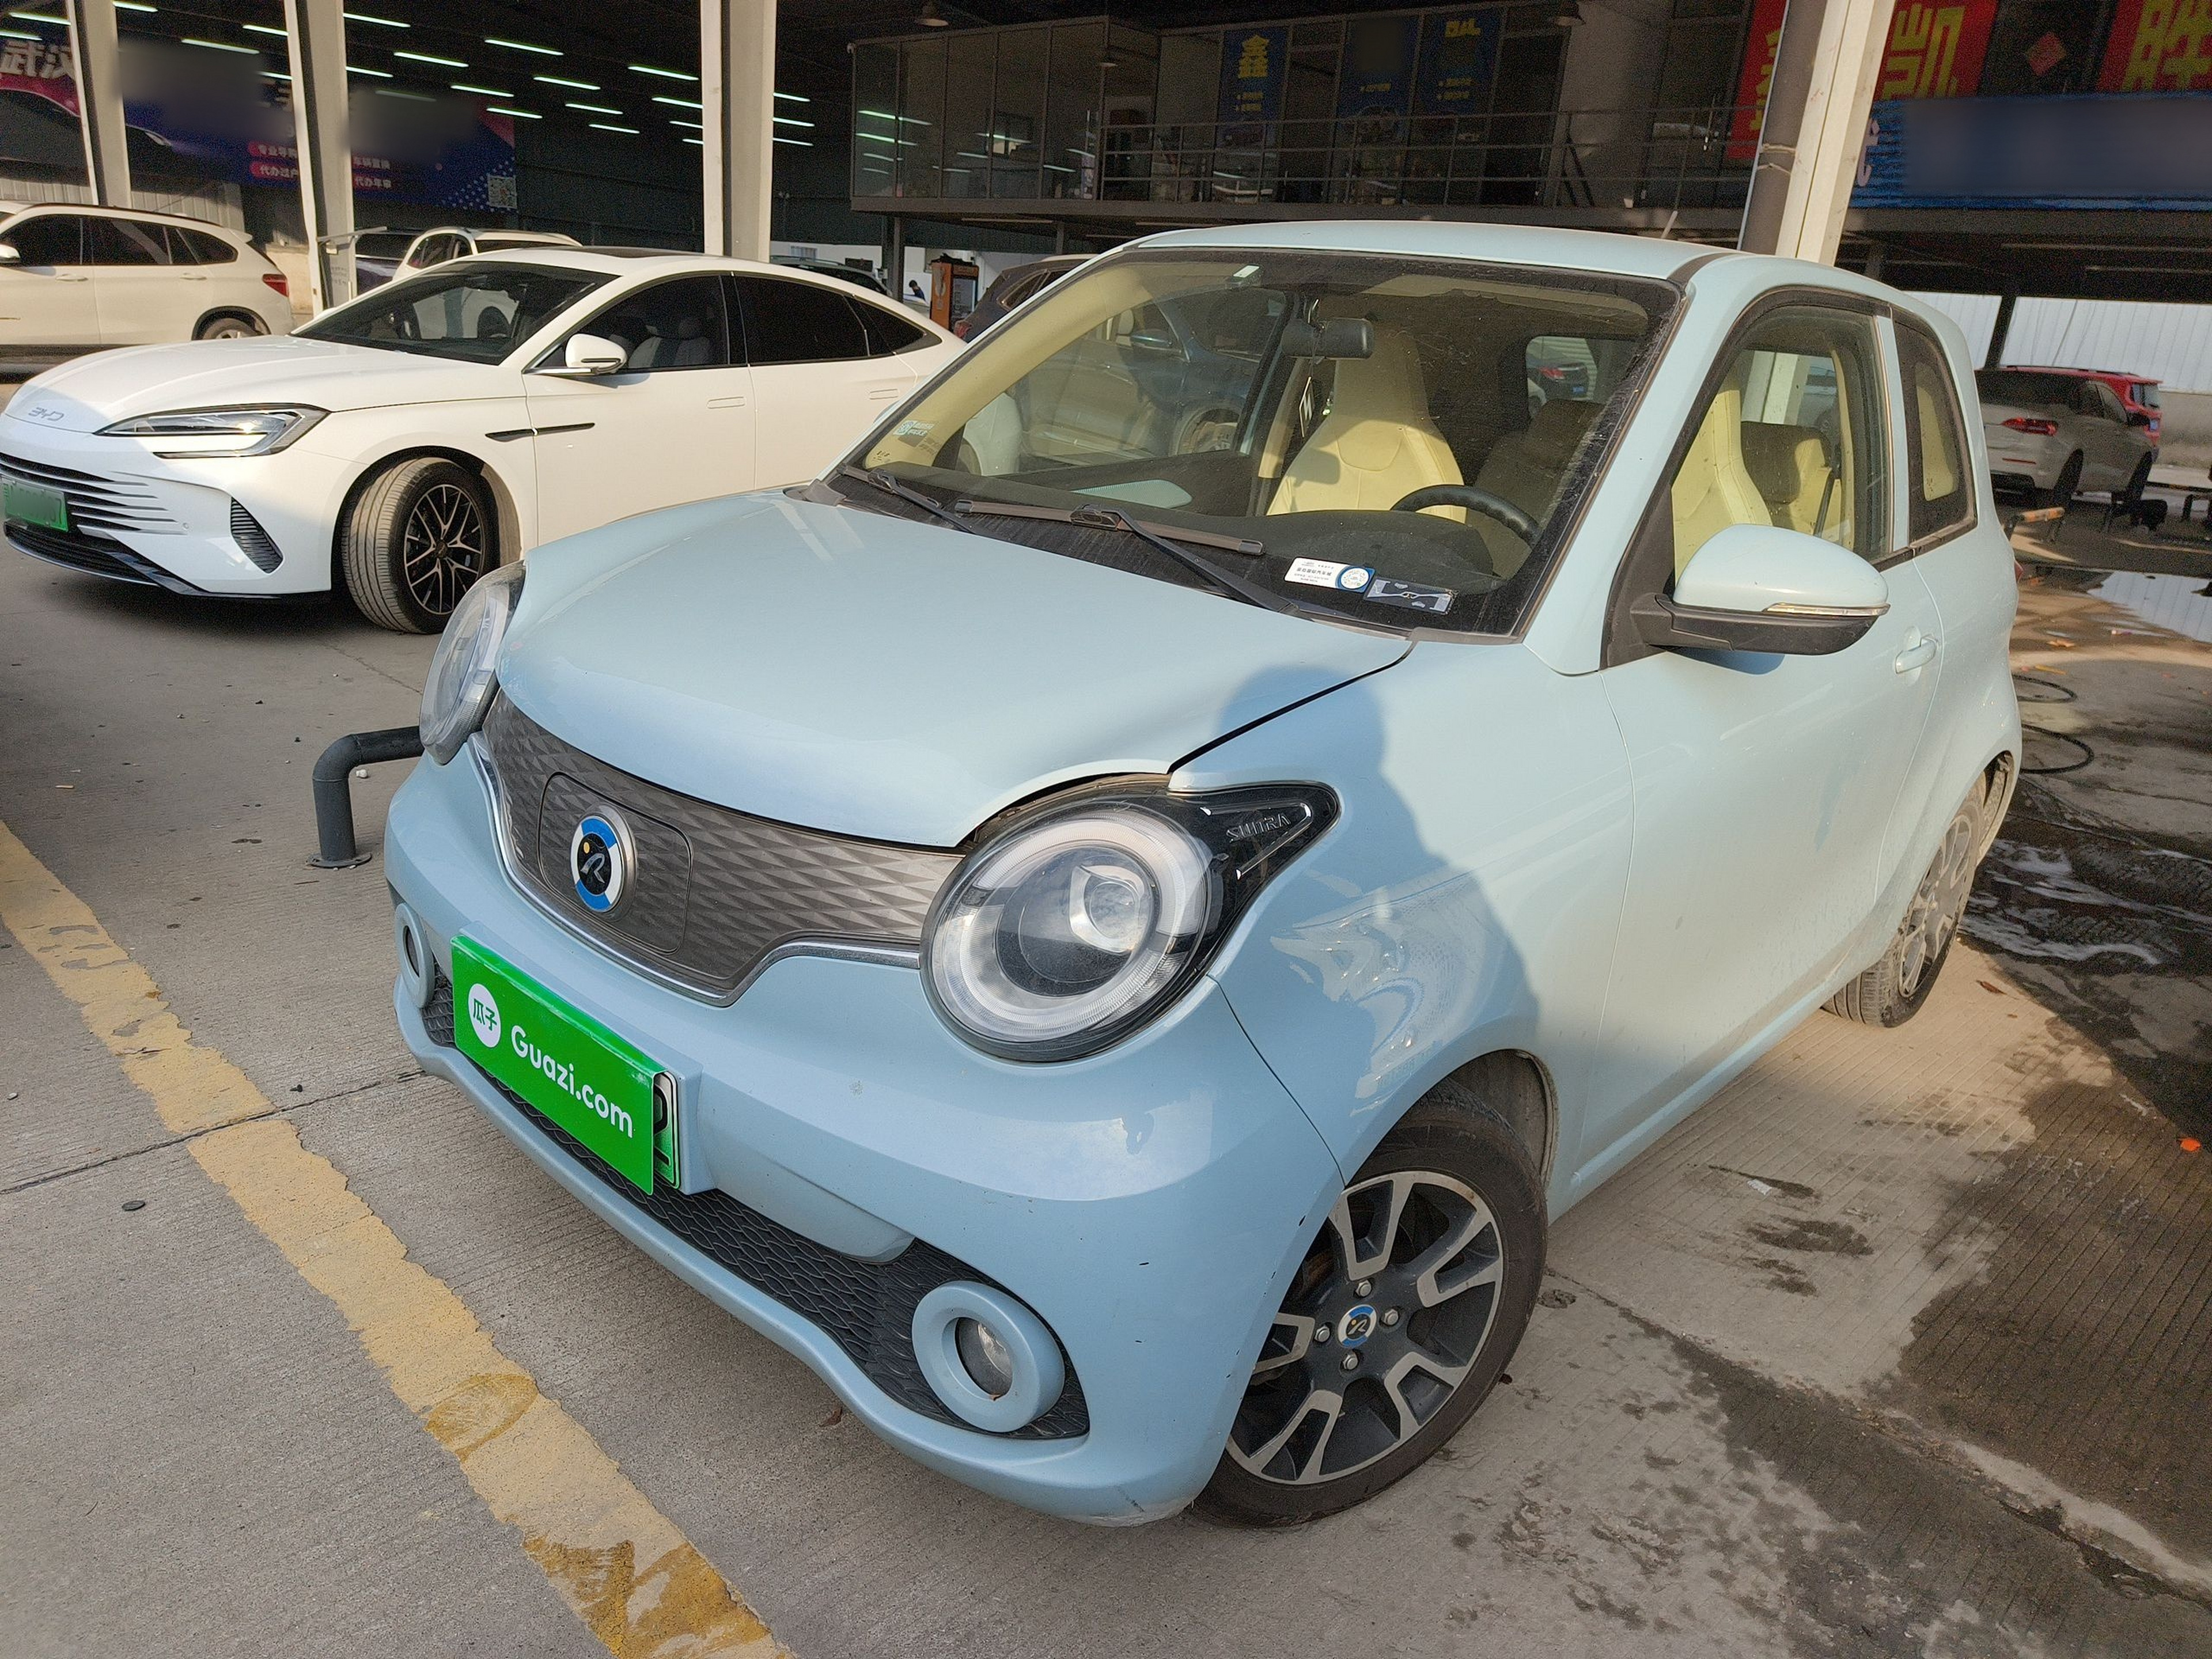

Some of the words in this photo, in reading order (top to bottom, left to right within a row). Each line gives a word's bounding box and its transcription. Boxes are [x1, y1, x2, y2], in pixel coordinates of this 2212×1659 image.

[28, 407, 65, 422] BYD
[472, 998, 498, 1031] 瓜子
[511, 1025, 632, 1138] Guazi.com
